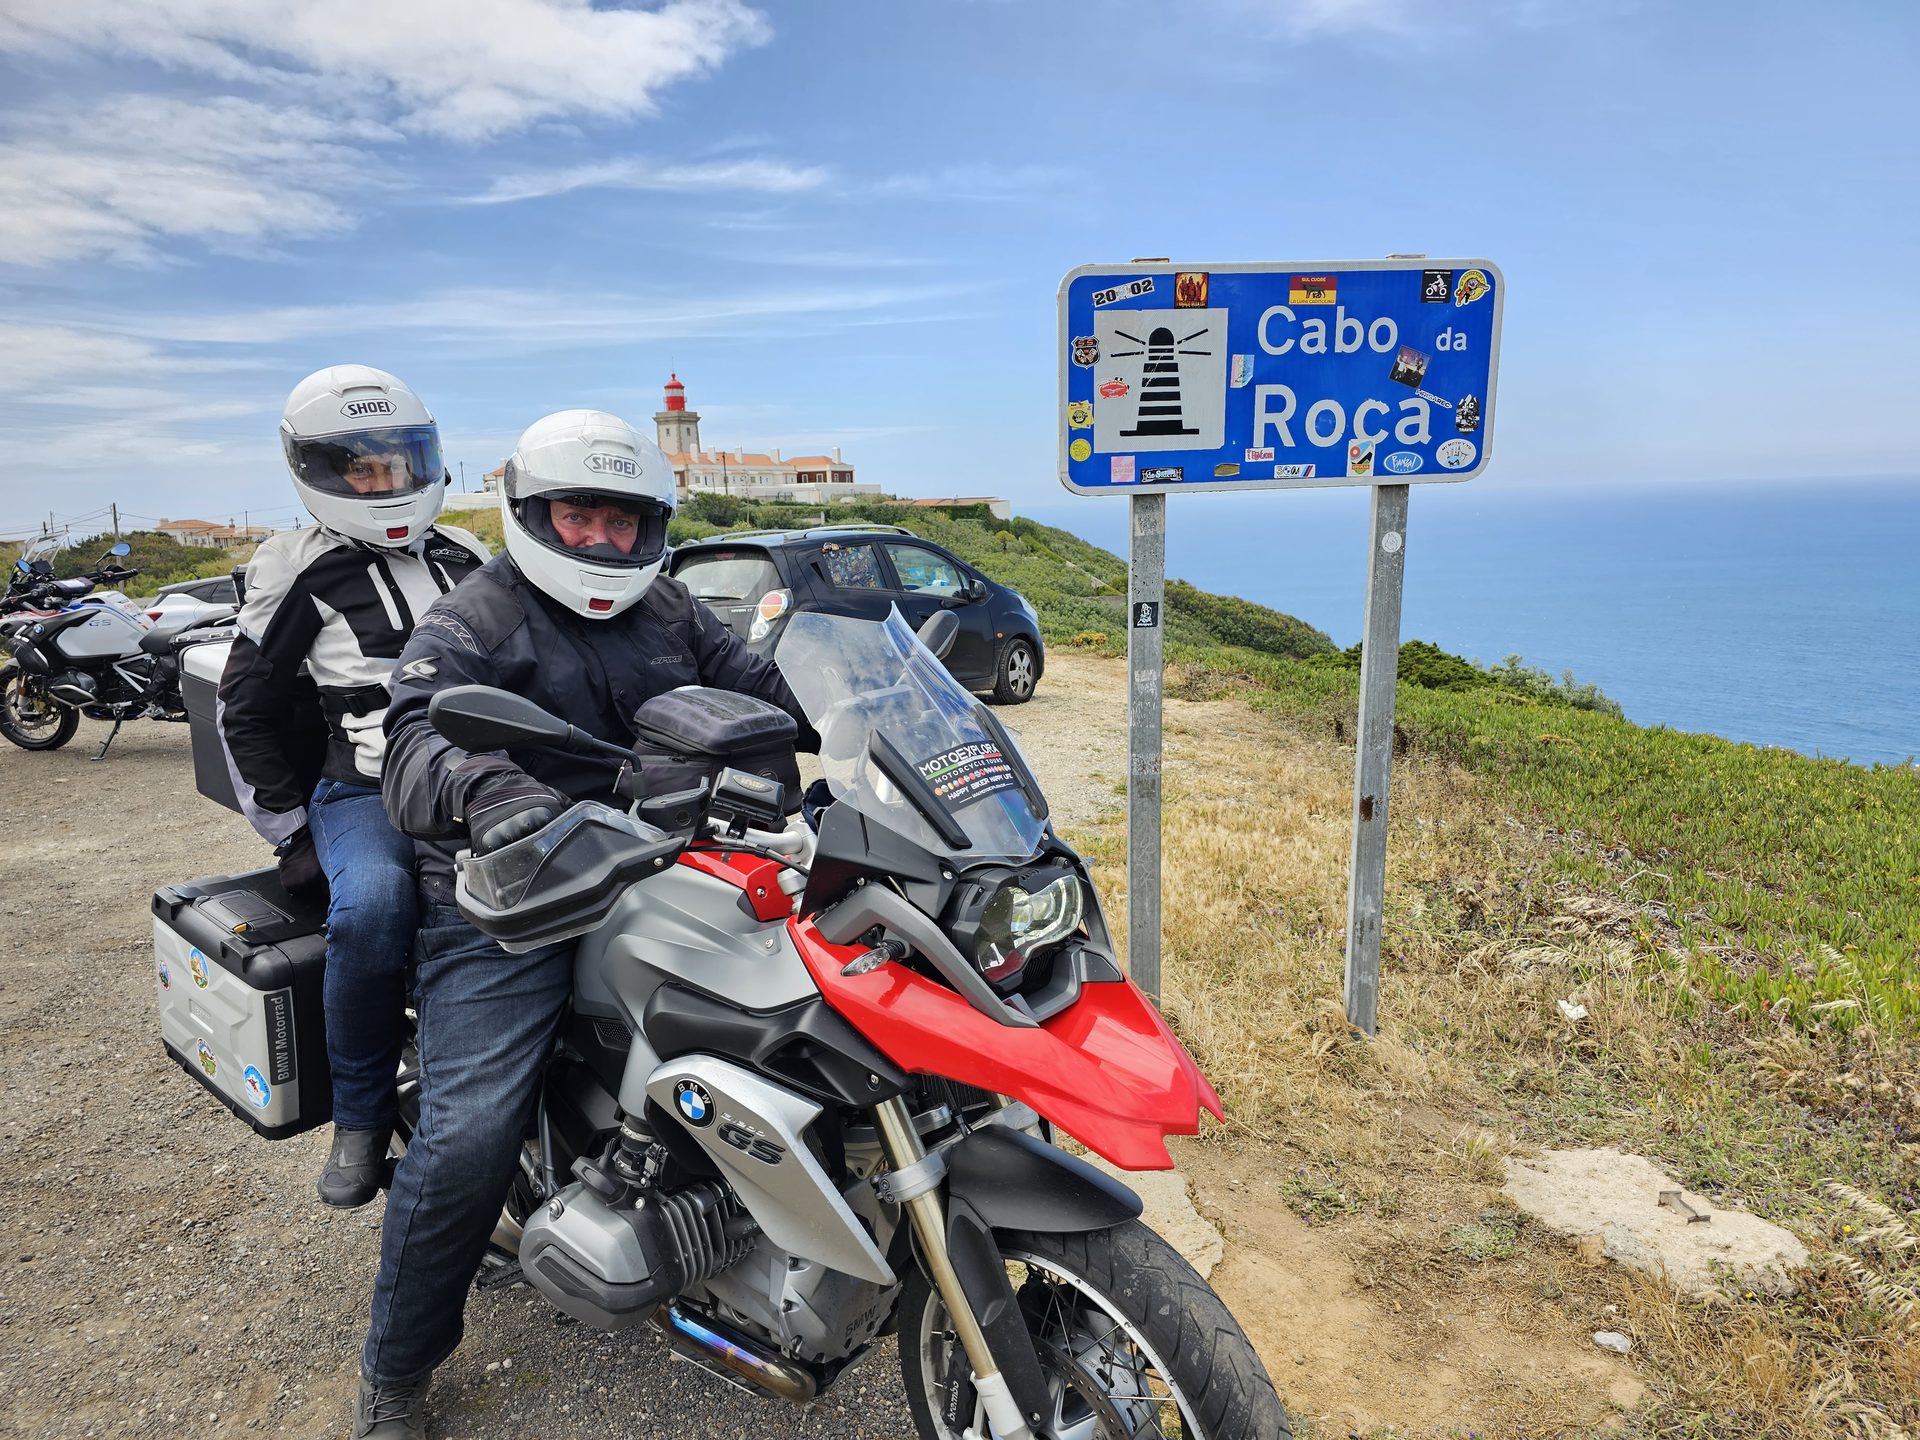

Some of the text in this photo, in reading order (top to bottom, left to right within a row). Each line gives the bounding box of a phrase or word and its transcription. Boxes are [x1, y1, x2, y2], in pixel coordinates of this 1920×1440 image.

[1257, 305, 1398, 355] Cabo
[1436, 326, 1467, 352] da
[347, 401, 391, 416] SHOEI
[1254, 384, 1432, 448] Roca
[592, 456, 636, 476] SHOEI
[918, 742, 1000, 777] MOTOEXPLORA
[934, 761, 985, 785] MOTORCYCLE
[947, 786, 969, 801] HAPPY
[970, 777, 991, 790] BIKER
[270, 996, 290, 1081] BMW Motorrad
[677, 1082, 712, 1105] BMW
[717, 1122, 786, 1166] GS
[947, 1380, 960, 1422] brembo
